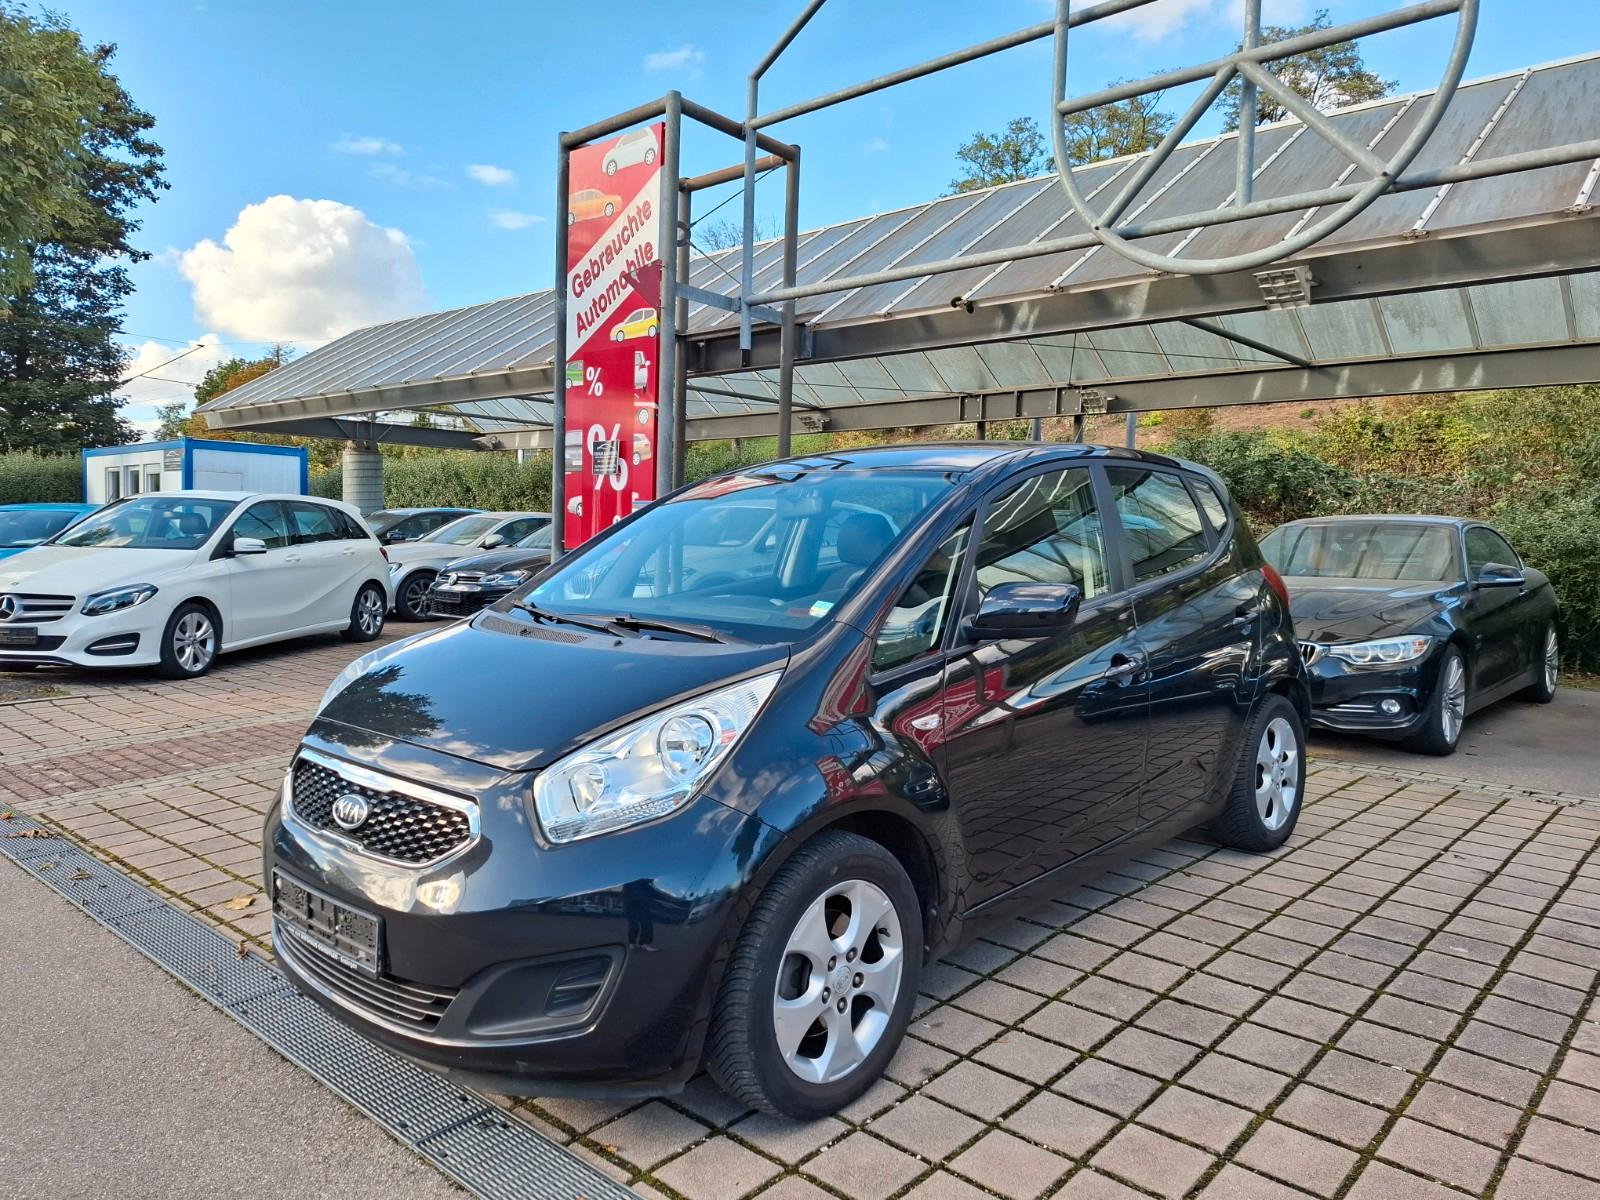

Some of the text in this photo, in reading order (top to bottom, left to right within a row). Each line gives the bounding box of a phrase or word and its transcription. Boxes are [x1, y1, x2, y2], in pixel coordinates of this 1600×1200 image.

[572, 200, 652, 298] Gebrauchte
[586, 366, 603, 396] %
[336, 799, 361, 823] KIA
